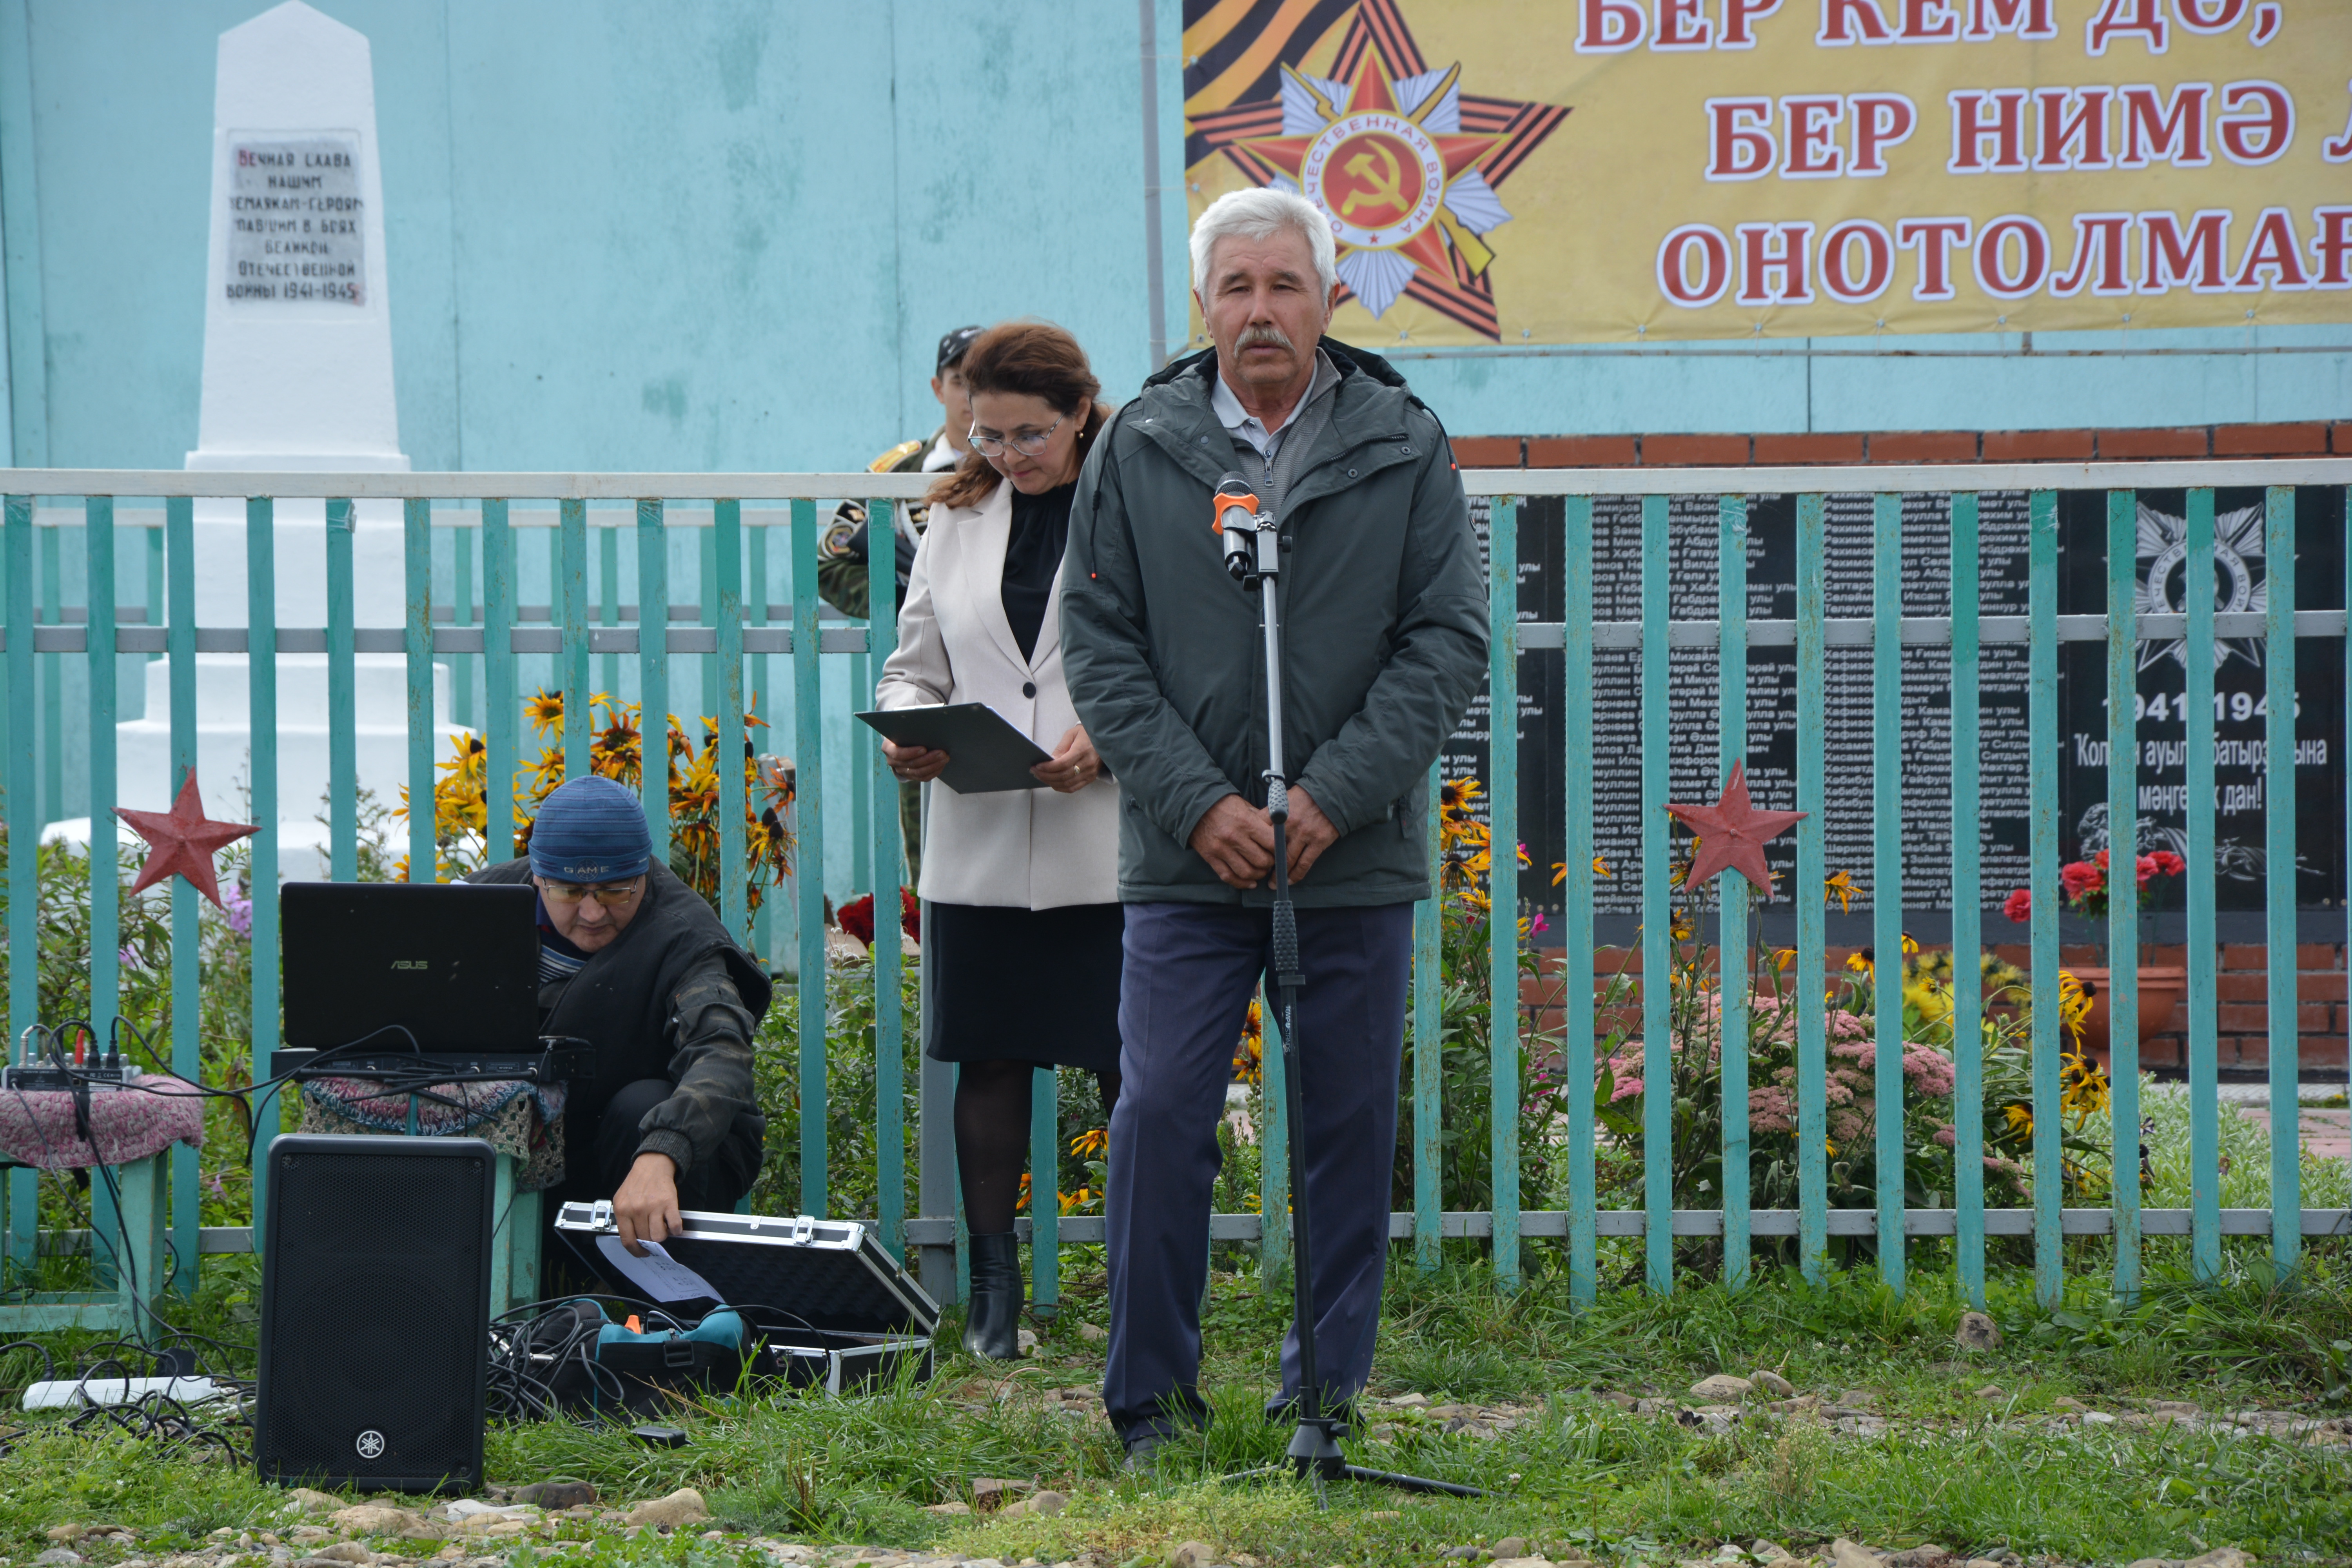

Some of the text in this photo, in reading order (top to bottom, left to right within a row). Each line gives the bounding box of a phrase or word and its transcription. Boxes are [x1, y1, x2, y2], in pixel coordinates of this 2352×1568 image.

[1575, 0, 1785, 54] БЕР
[1704, 92, 1917, 181] БЕР
[1947, 80, 2296, 174] НИМӘ
[1307, 116, 1429, 233] ОЕЧЕСТВЕННАЯ
[1824, 581, 1875, 593] Саттаро
[1992, 737, 2031, 748] Ситды
[2223, 776, 2263, 815] дан!
[1825, 843, 1875, 855] Шәрипо
[390, 961, 428, 969] ASUS
